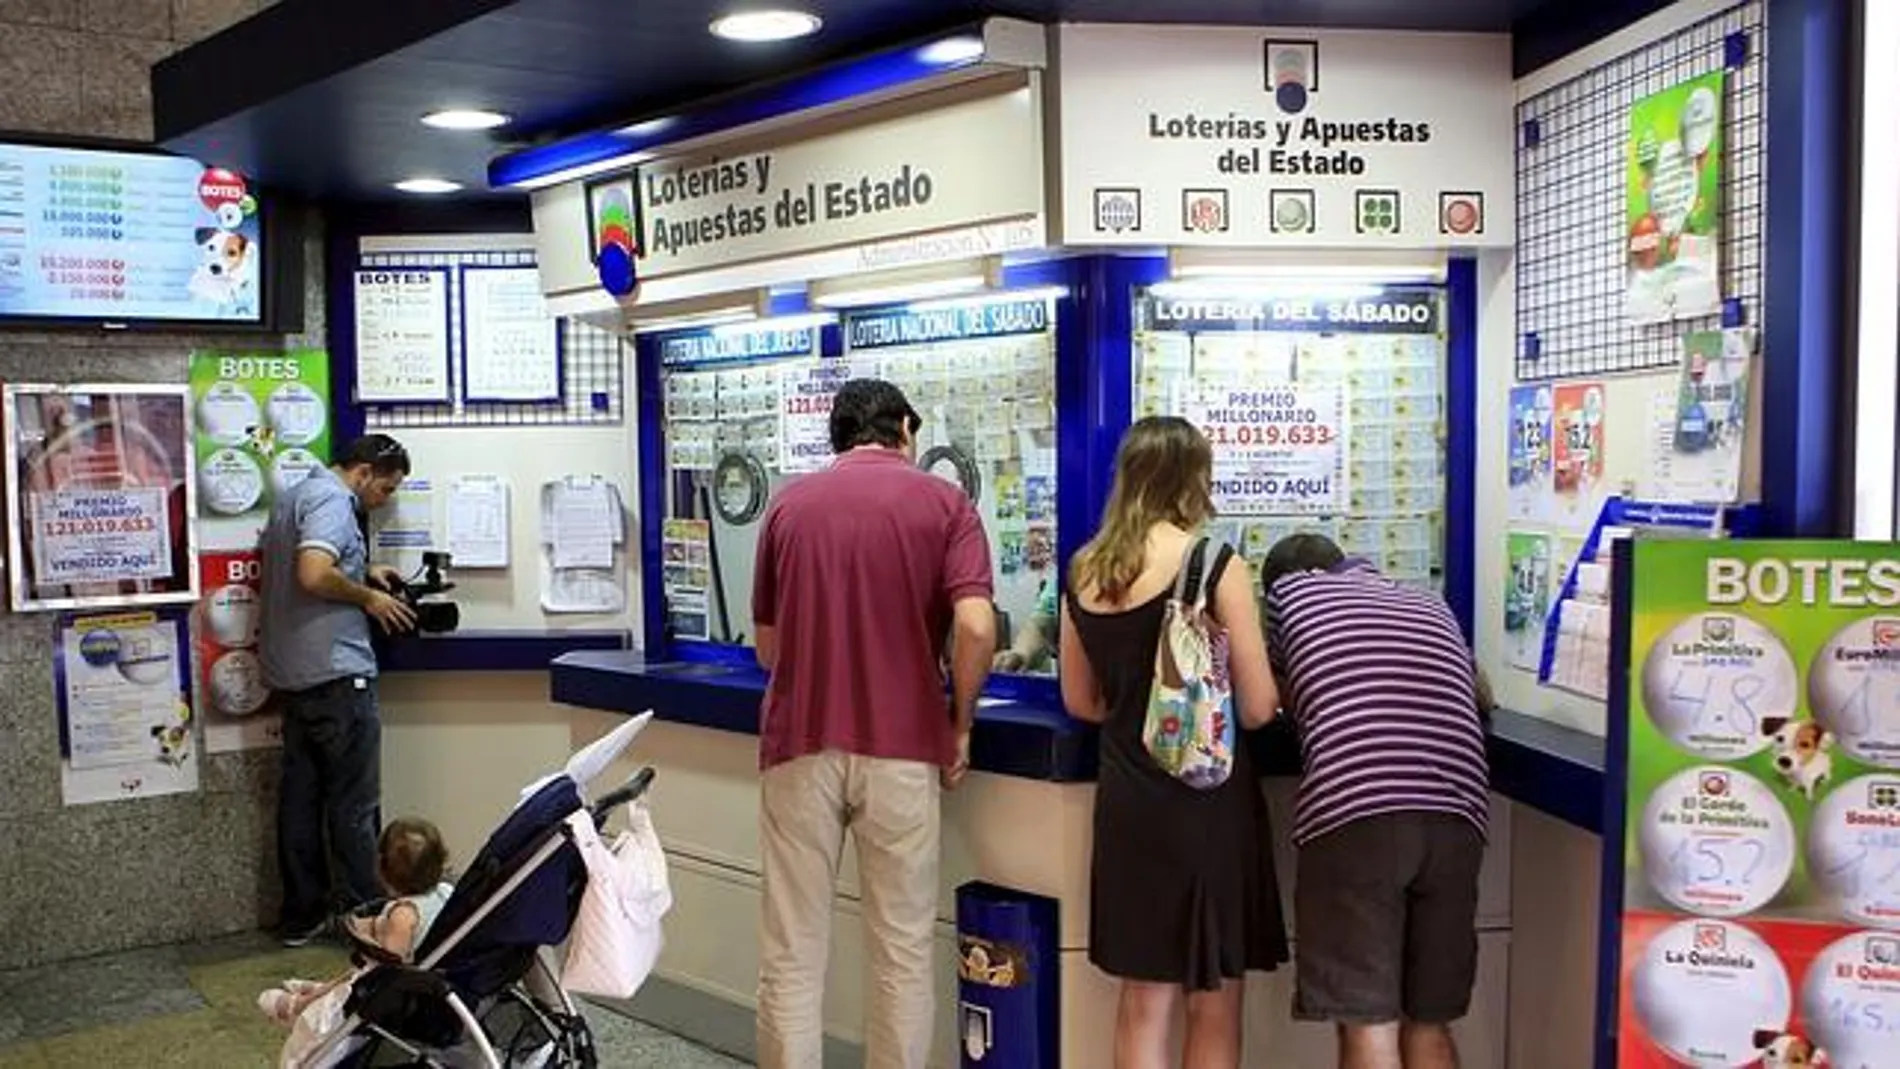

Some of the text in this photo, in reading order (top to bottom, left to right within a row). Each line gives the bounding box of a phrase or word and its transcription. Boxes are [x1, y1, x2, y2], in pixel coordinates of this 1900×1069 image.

[1149, 112, 1431, 147] Loterías y Apuestas
[1218, 148, 1365, 176] del Estado
[647, 154, 772, 206] Loterías y
[201, 184, 242, 200] BOTES
[651, 164, 933, 257] Apuestas del Estado
[359, 273, 431, 285] BOTES
[1273, 302, 1321, 321] DEL
[219, 356, 301, 380] BOTES
[1228, 392, 1297, 408] PREMIO
[1207, 409, 1317, 423] MILLONARIO
[1201, 425, 1330, 445] 21.019.633
[1282, 474, 1330, 498] AQUÍ
[74, 495, 128, 507] PREMIO
[58, 505, 142, 519] MILLONARIO
[51, 557, 118, 571] VENDIDO
[1707, 557, 1900, 606] BOTES
[1671, 642, 1764, 657] La Primitiva
[1681, 797, 1746, 811] El Gordo
[1658, 812, 1769, 829] de la Primitiva
[1665, 950, 1755, 969] La Quiniela
[1836, 962, 1853, 977] El
